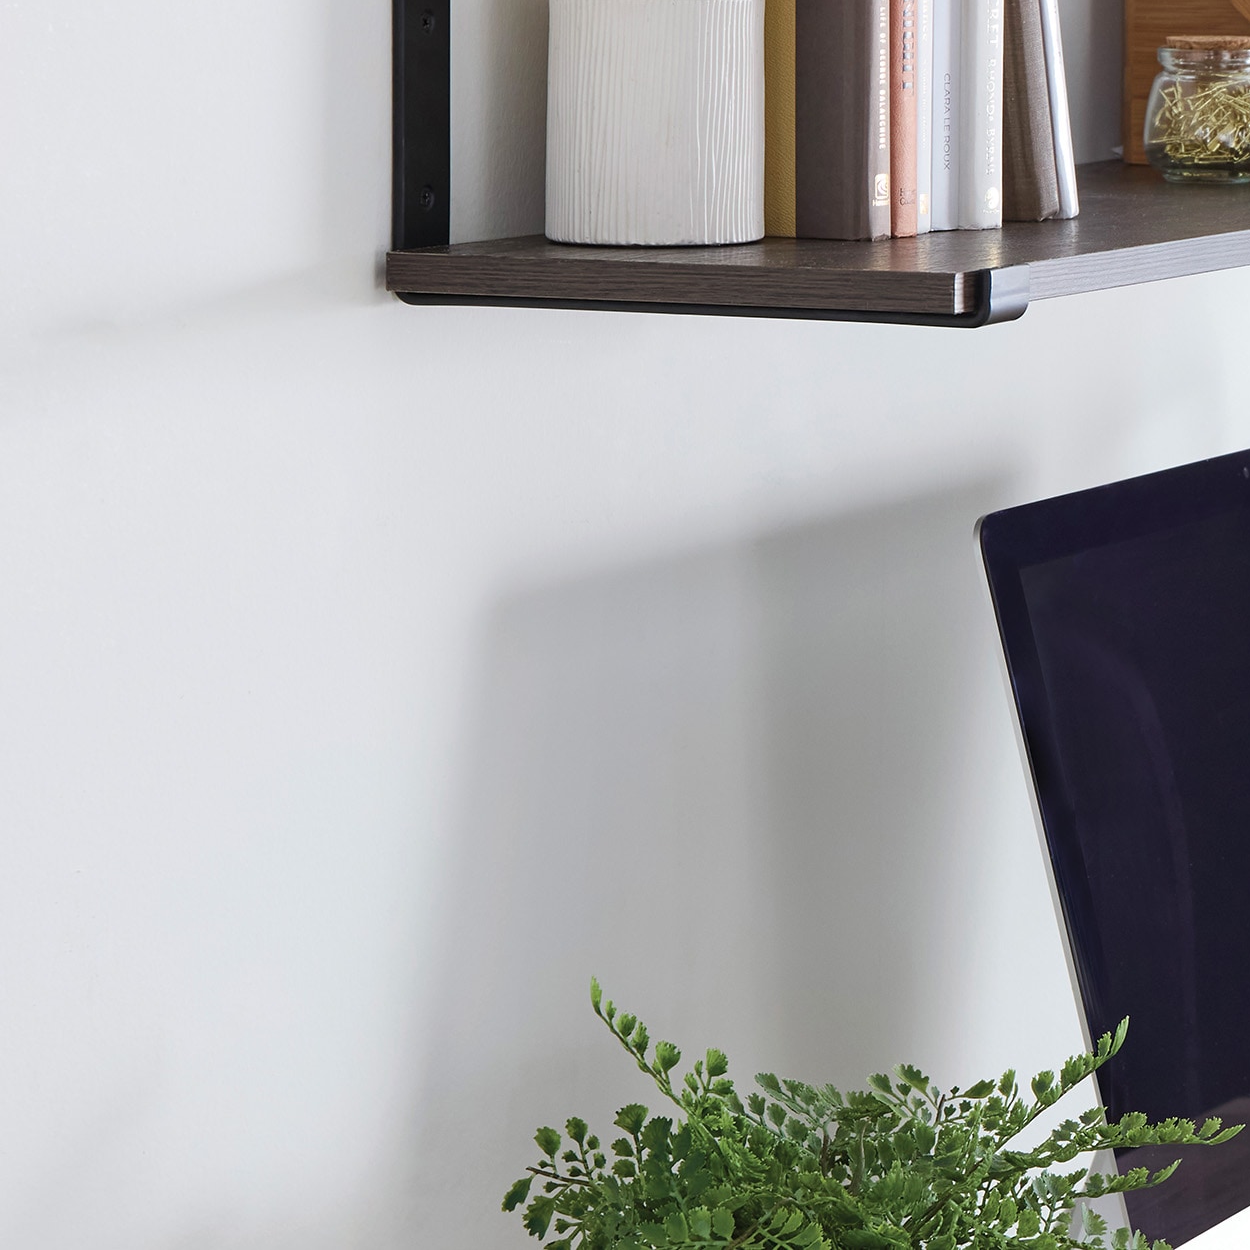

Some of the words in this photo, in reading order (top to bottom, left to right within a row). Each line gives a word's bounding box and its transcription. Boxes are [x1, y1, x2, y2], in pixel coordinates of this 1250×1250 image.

[879, 33, 886, 43] OF
[943, 72, 951, 114] CLARA
[943, 117, 950, 130] LE
[942, 135, 950, 171] ROUX
